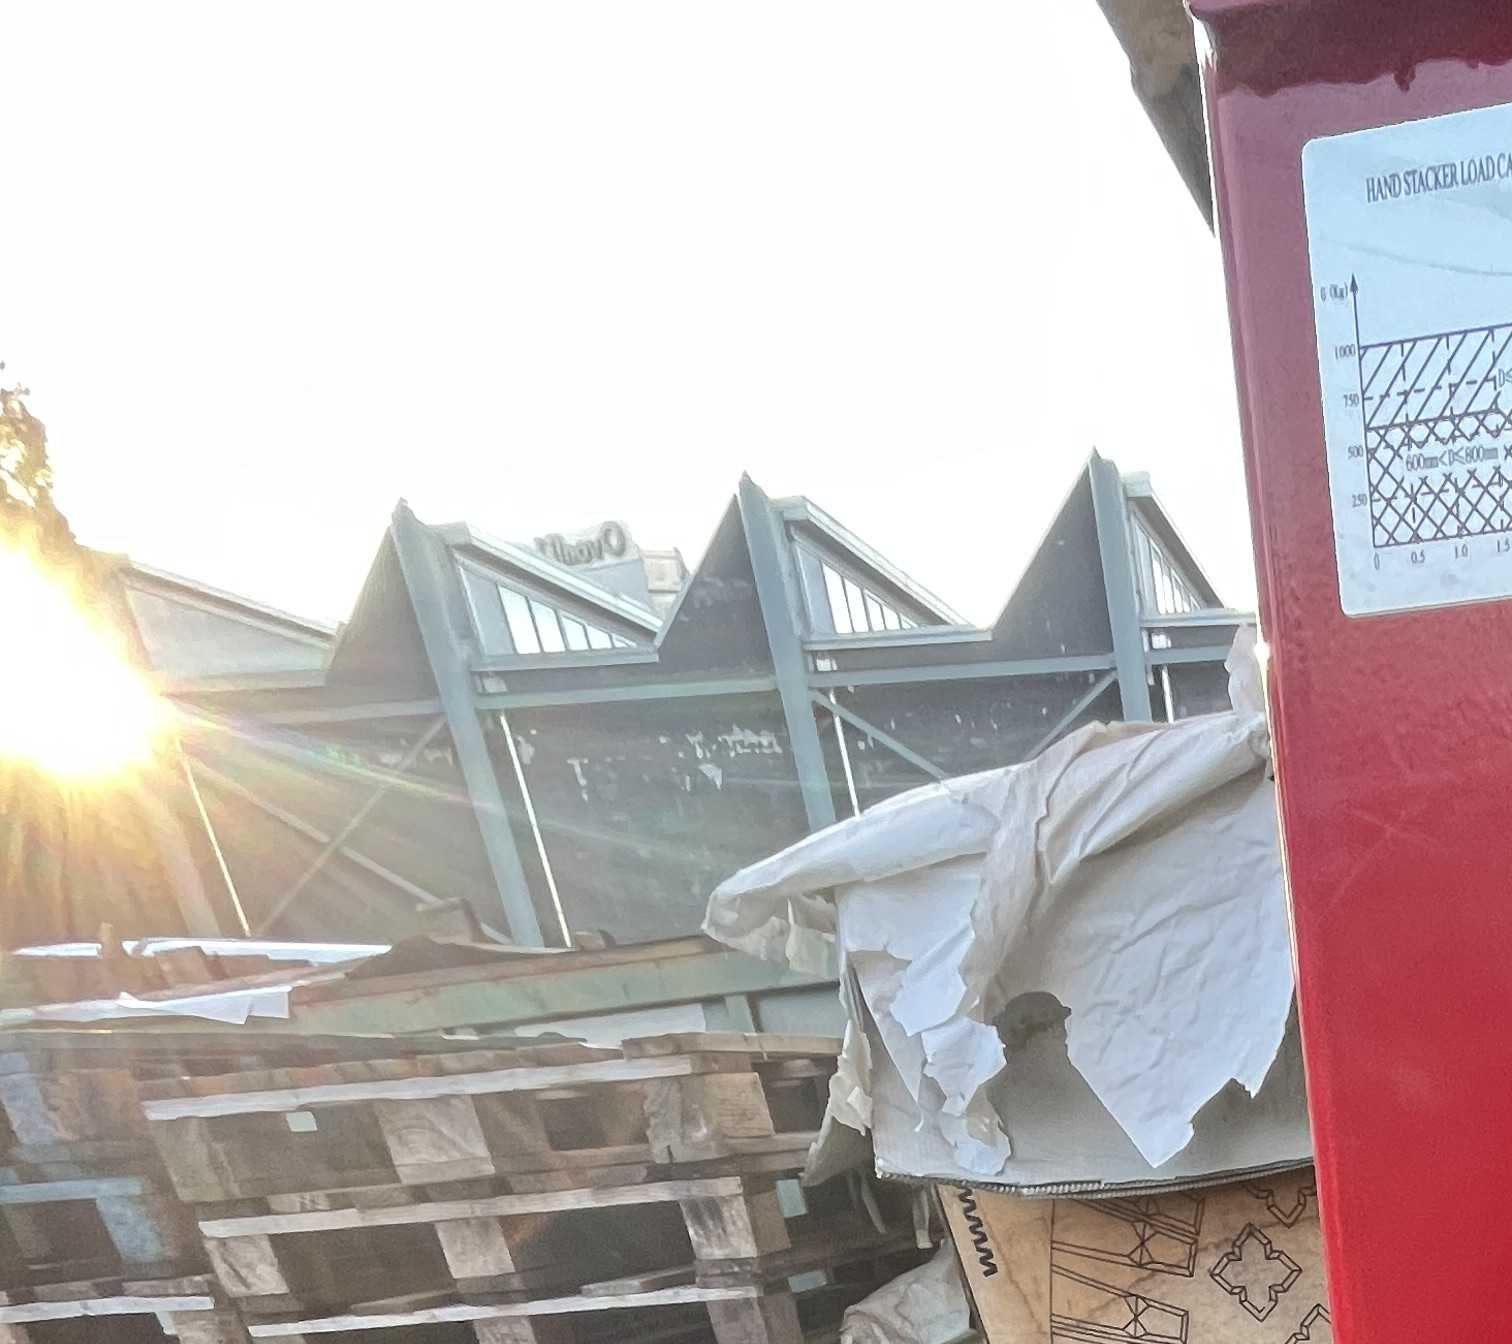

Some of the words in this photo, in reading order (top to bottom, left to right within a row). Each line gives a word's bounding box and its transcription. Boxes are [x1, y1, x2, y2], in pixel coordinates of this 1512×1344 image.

[1366, 174, 1401, 203] HAND
[1403, 164, 1459, 196] STACKER
[1460, 155, 1495, 186] LOAD
[1335, 343, 1356, 360] 1000
[1344, 393, 1360, 409] 750
[1348, 445, 1364, 460] 500
[1352, 494, 1368, 508] 250
[1373, 552, 1380, 570] 0
[1411, 549, 1425, 564] 0.5
[1455, 543, 1468, 559] 1.0
[1497, 538, 1510, 553] 1.5
